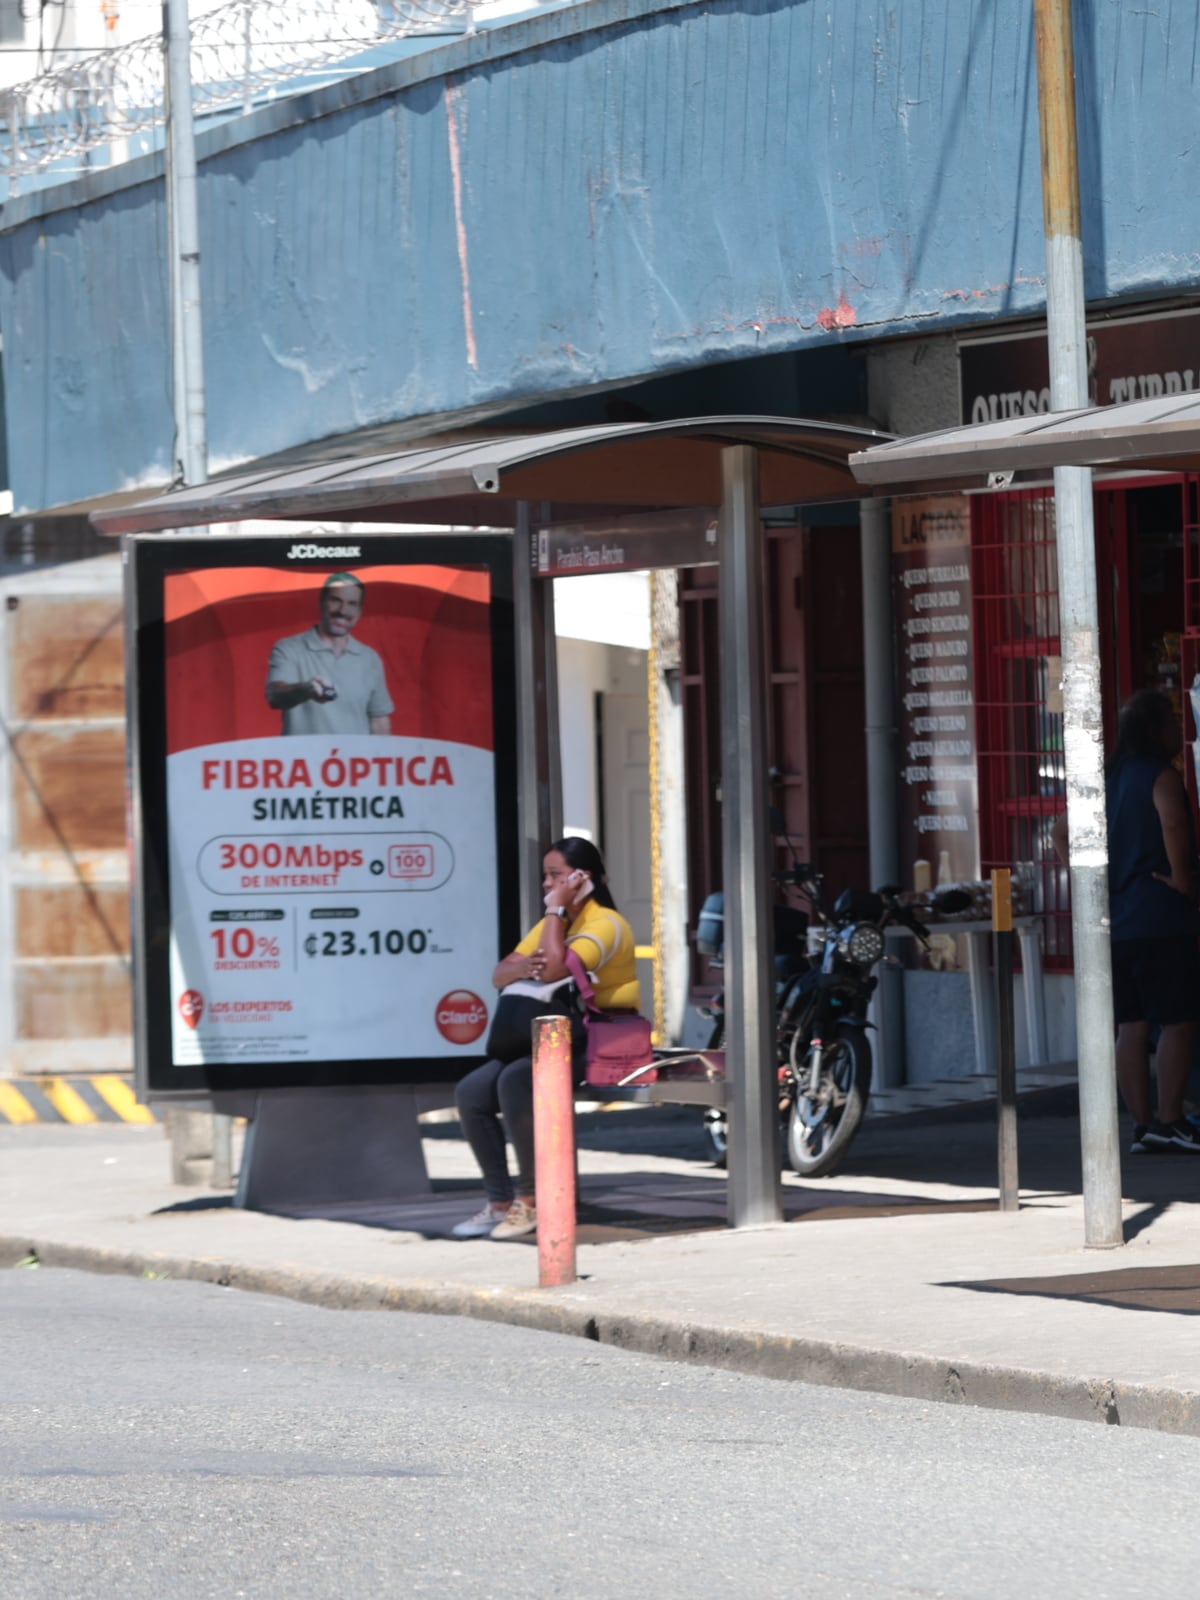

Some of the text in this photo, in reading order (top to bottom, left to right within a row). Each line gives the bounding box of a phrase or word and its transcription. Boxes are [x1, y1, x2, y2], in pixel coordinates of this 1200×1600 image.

[286, 543, 361, 559] JCDecaux
[202, 748, 455, 790] FIBRA ÓPTICA
[253, 791, 405, 821] SIMÉTRICA
[220, 843, 364, 873] 300Mbps
[395, 854, 426, 868] 100
[241, 874, 339, 888] DE INTERNET
[211, 927, 280, 959] 10%
[438, 1010, 480, 1024] Claro
